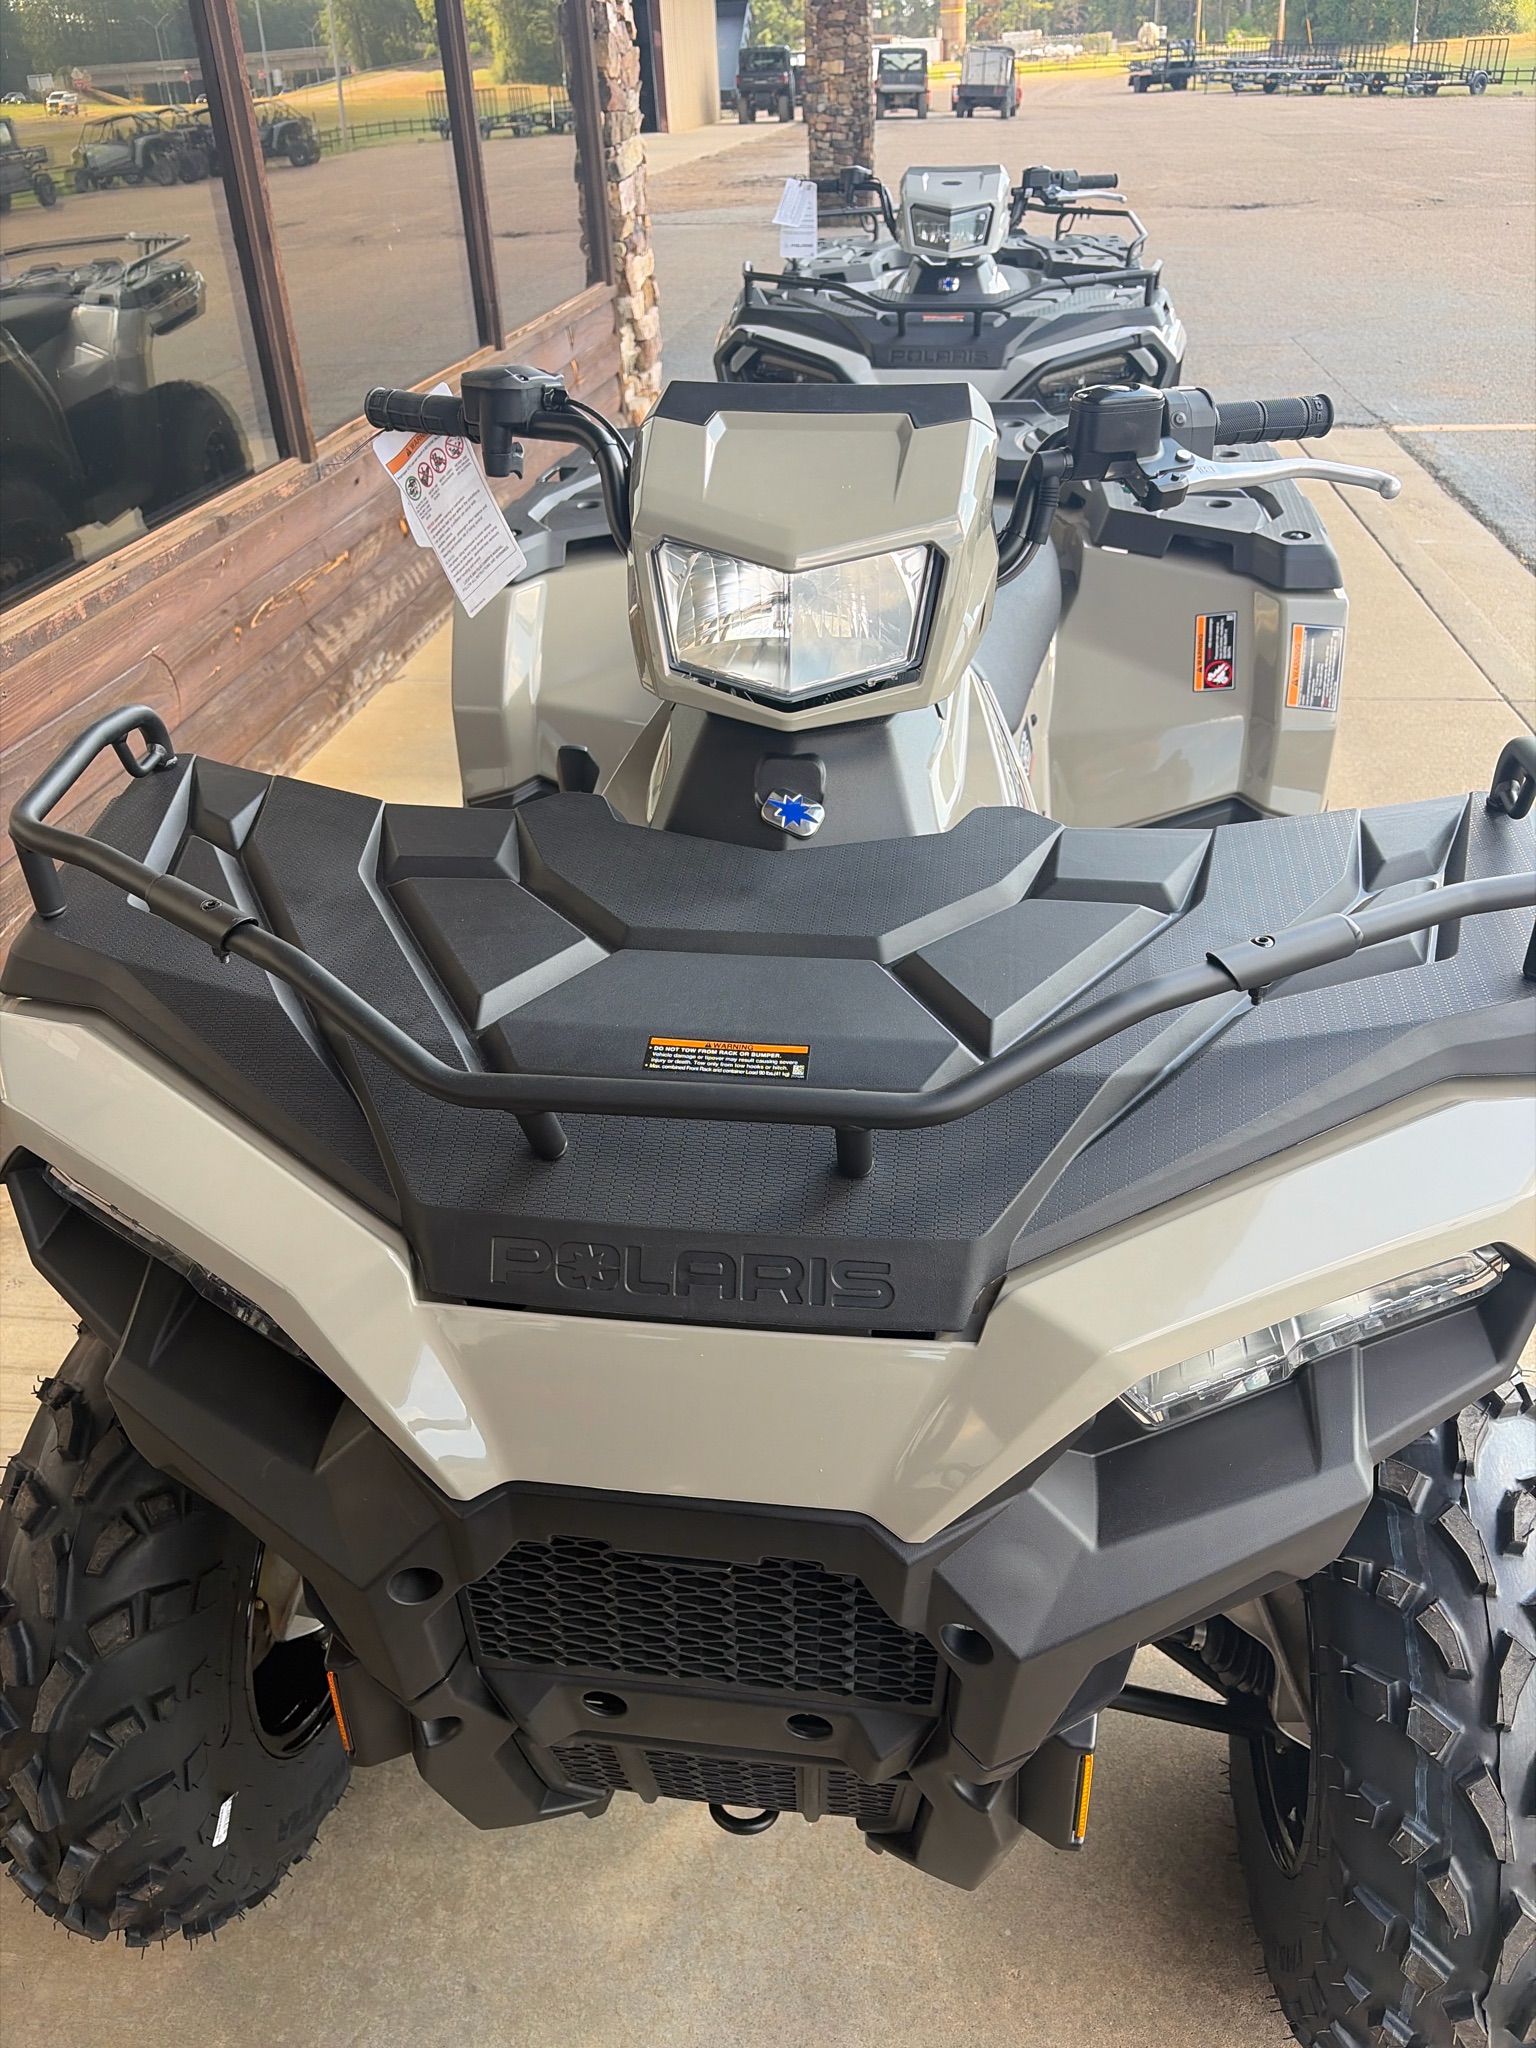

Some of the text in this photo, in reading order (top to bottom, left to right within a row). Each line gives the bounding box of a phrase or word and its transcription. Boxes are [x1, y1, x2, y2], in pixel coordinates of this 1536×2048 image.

[889, 348, 989, 363] POLARIS
[1292, 644, 1301, 679] WARNING
[713, 1042, 754, 1051] WARNING
[490, 1236, 896, 1309] POLARIS
